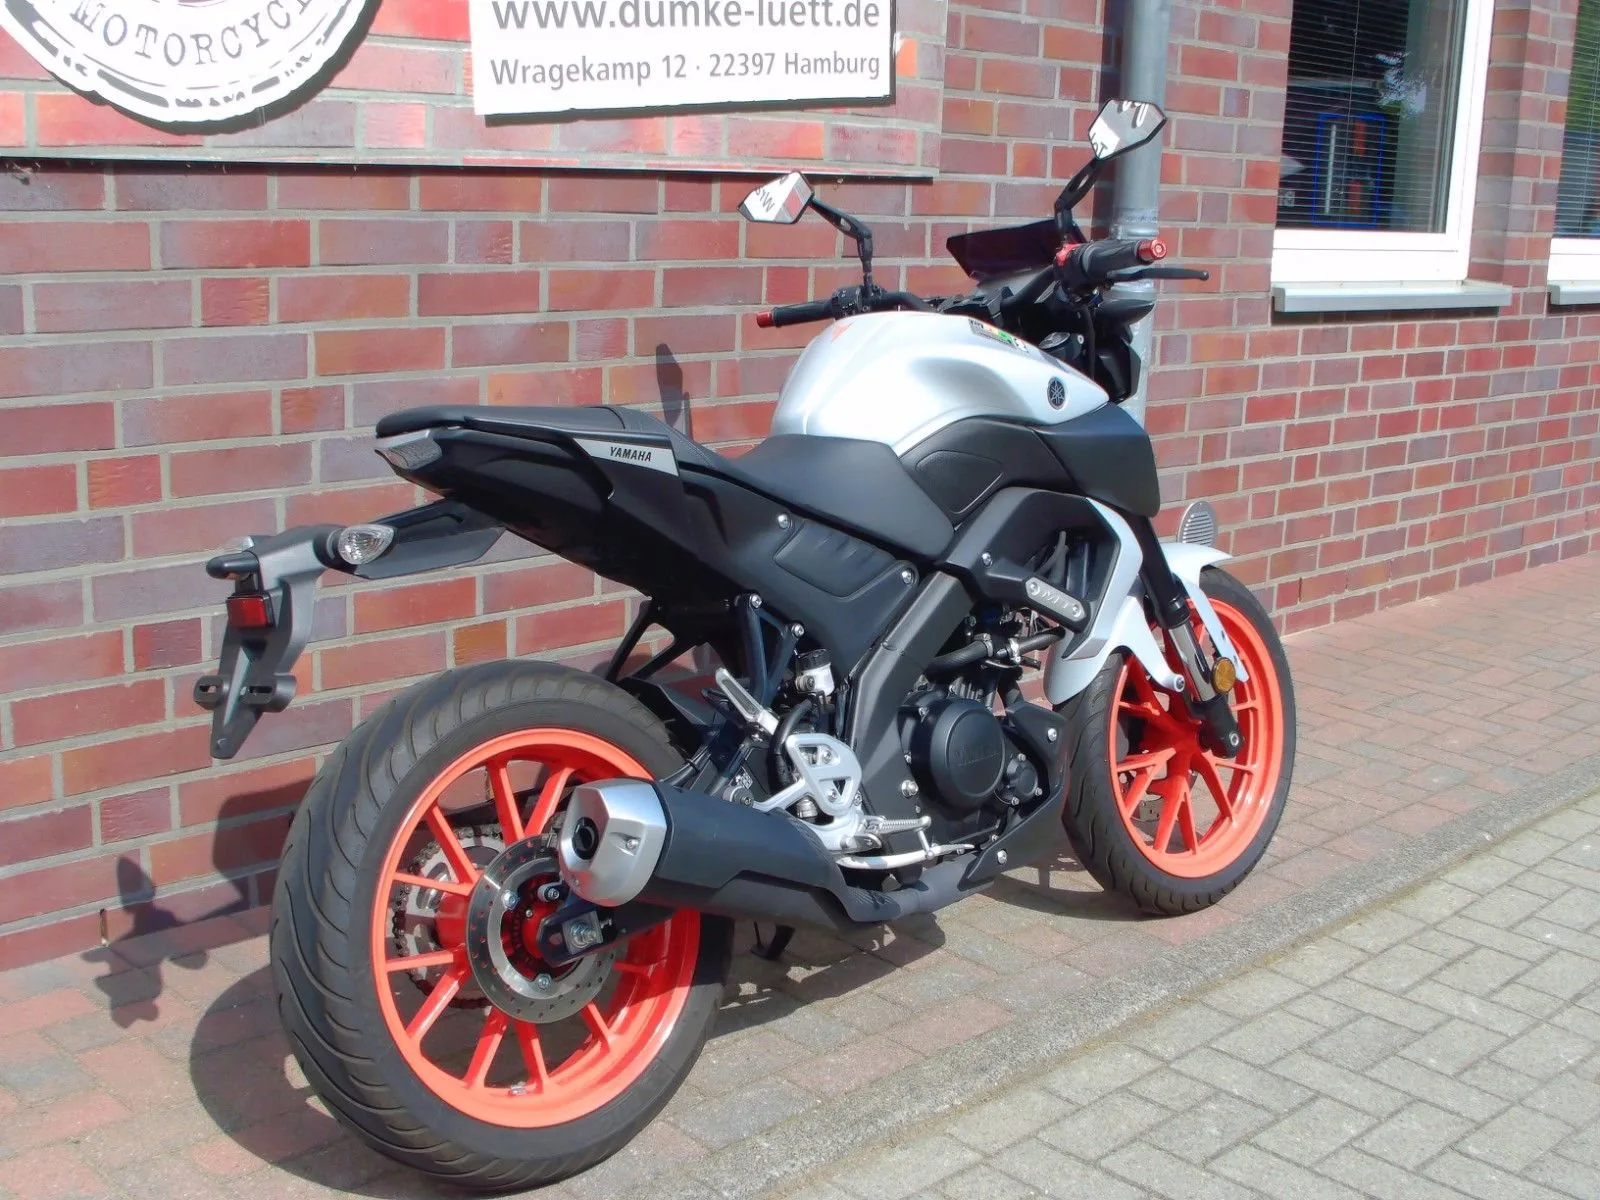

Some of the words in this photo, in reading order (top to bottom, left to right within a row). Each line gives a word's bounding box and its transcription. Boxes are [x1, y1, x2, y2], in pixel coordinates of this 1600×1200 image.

[492, 0, 880, 29] www.dumke-luett.de
[491, 55, 651, 90] Wragekamp
[662, 54, 687, 78] 12
[709, 53, 776, 77] 22397
[785, 50, 880, 80] Hamburg
[610, 446, 652, 462] YAMAHA
